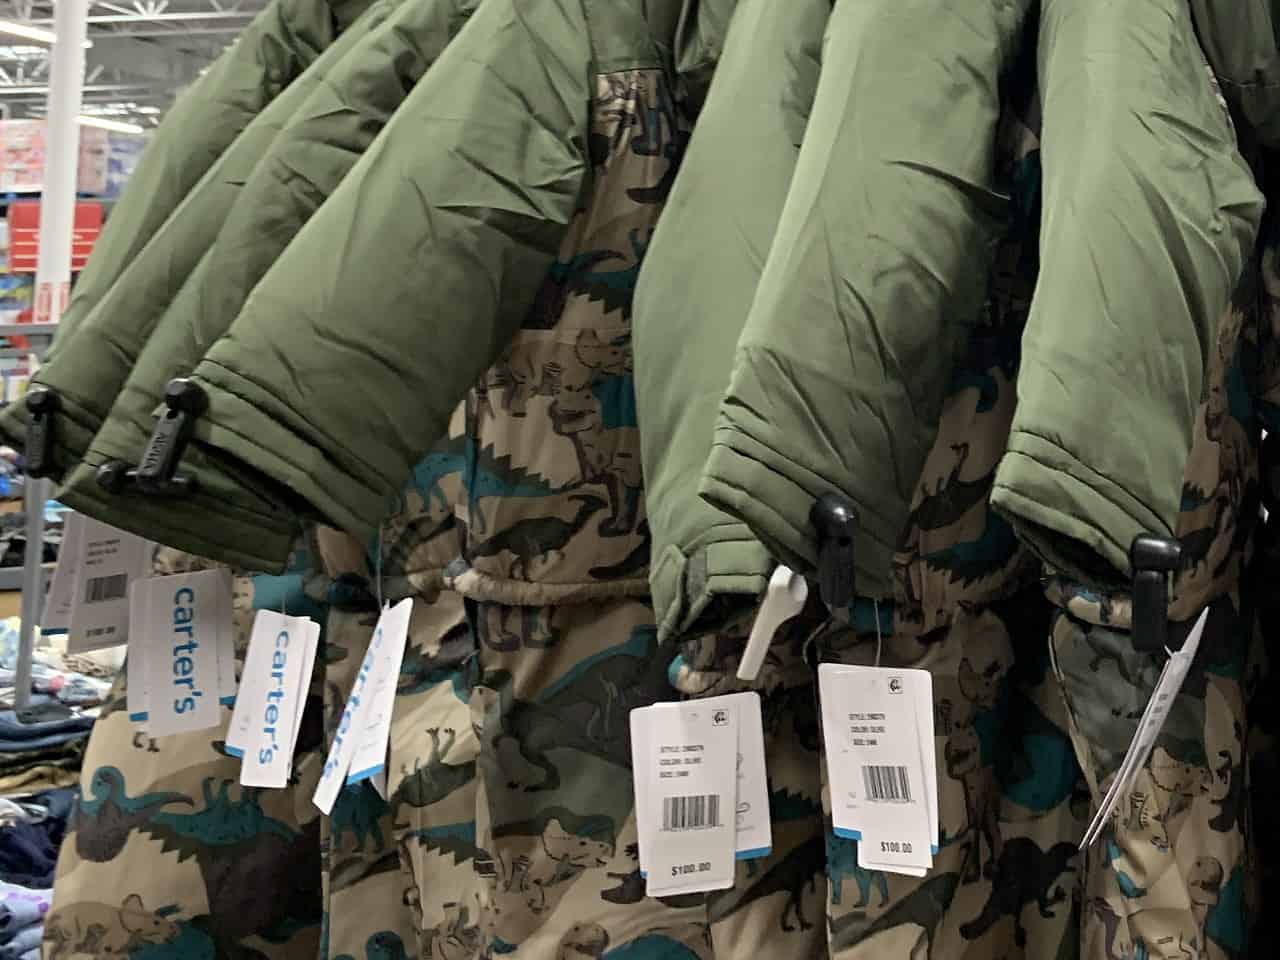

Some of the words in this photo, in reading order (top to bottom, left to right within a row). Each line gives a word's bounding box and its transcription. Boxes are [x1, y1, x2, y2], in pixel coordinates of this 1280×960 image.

[172, 587, 202, 714] carter's
[258, 630, 289, 764] carter's
[671, 861, 712, 877] $100.00
[880, 841, 912, 854] $100.00
